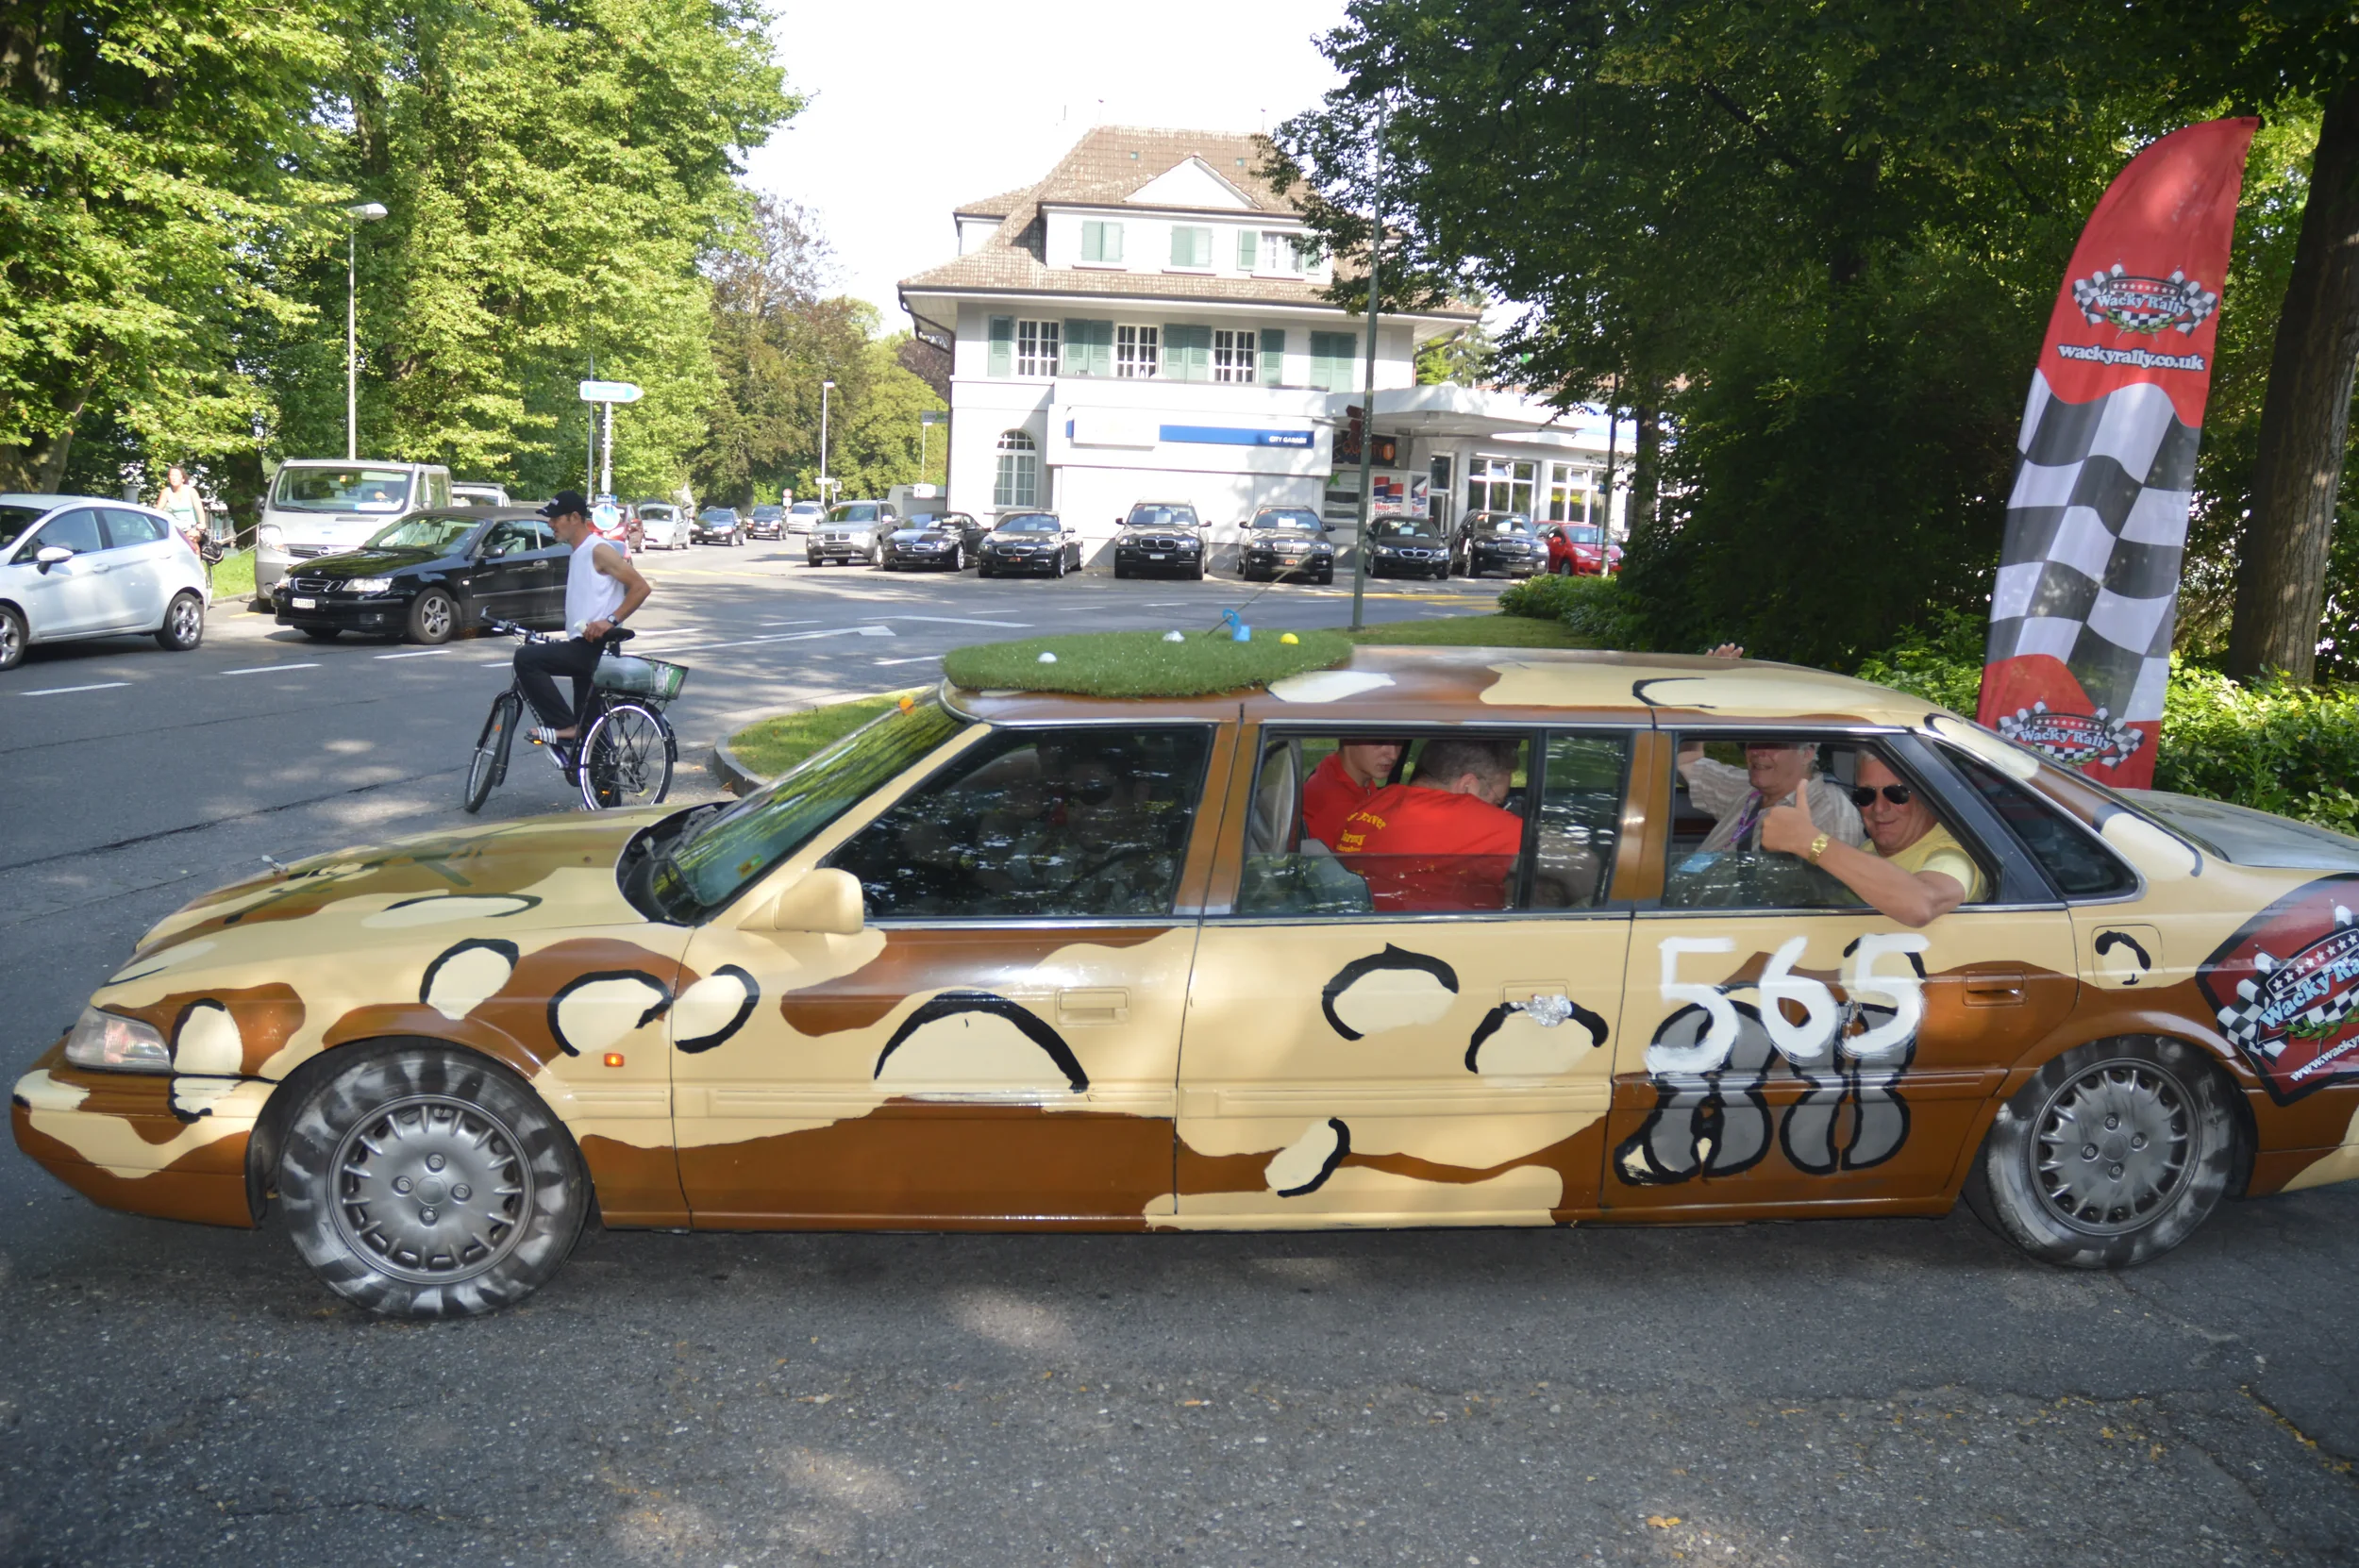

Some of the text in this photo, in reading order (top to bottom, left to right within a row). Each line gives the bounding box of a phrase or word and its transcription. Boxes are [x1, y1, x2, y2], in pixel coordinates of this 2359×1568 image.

[2095, 293, 2189, 317] Wacky Rally
[2057, 343, 2205, 371] wackyrally.co.uk
[2019, 728, 2115, 751] Wacky Rally
[1644, 932, 1931, 1076] 565
[2259, 972, 2332, 1028] Wacky
[2289, 1034, 2359, 1082] www.wacky
